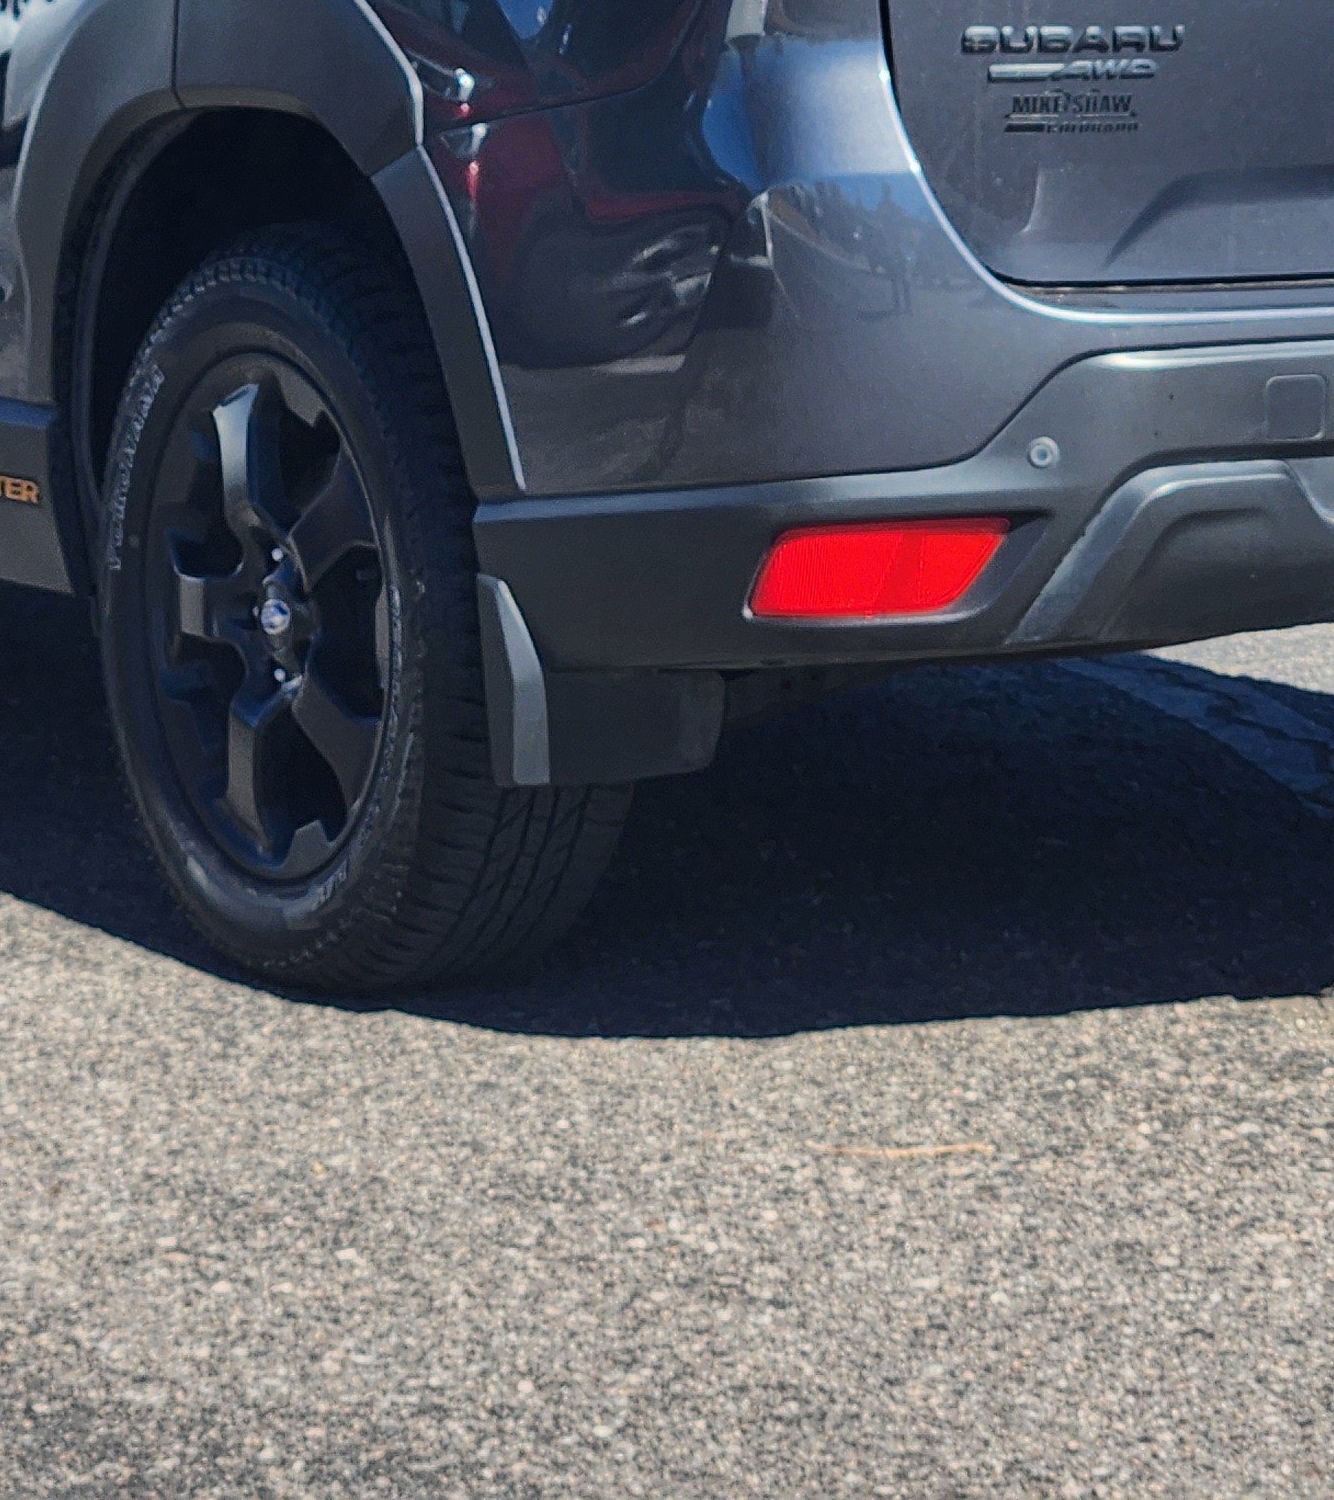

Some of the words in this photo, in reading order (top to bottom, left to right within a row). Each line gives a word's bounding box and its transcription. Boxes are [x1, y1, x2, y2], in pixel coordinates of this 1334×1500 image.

[961, 25, 1186, 53] SUBARU
[1011, 94, 1065, 113] MIKE
[1067, 94, 1133, 113] SHAW
